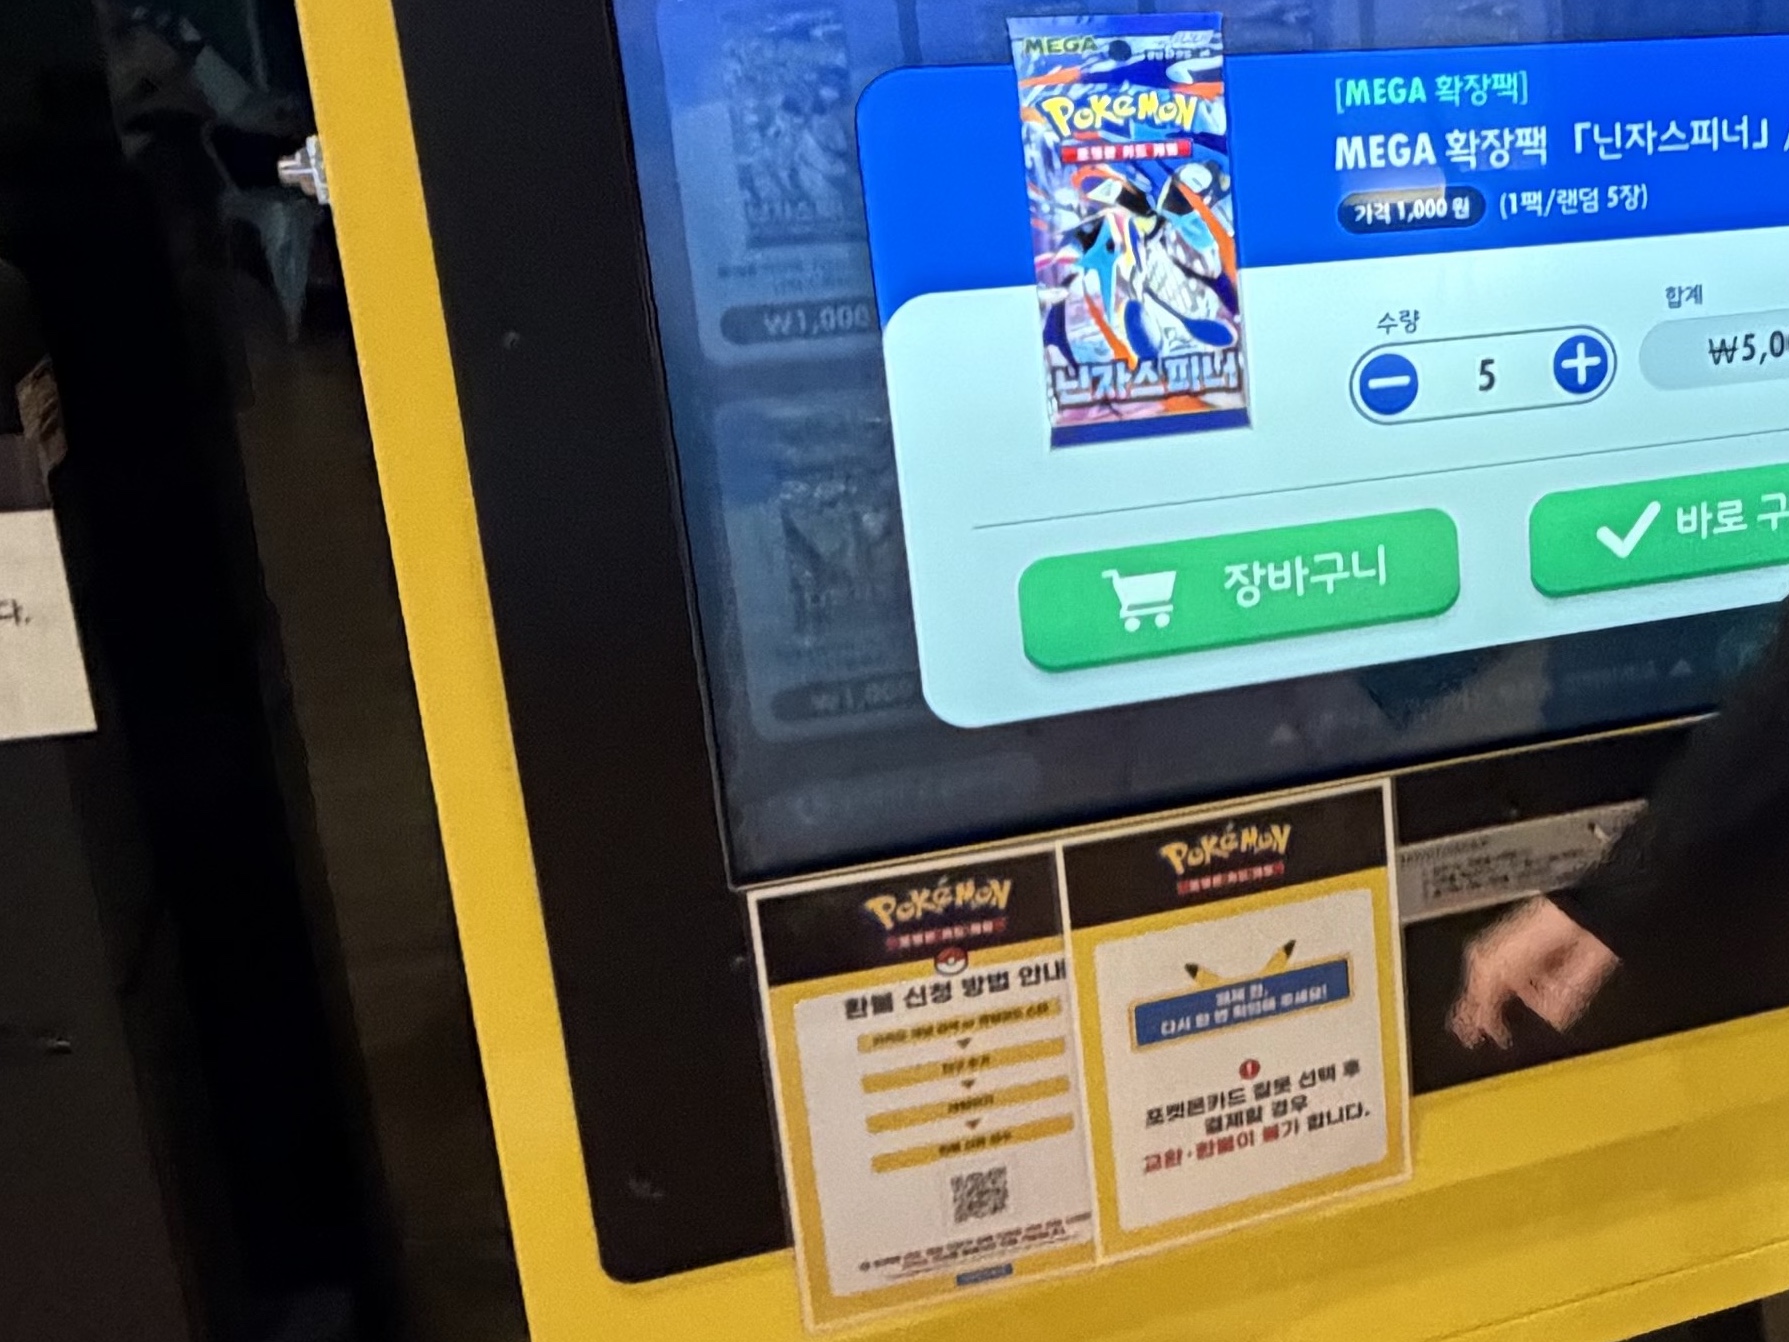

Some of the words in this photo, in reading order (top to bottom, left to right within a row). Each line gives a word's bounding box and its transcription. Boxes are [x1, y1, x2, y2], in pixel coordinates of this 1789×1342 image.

[1025, 36, 1098, 54] MEGA
[1335, 77, 1427, 115] [MEGA
[1435, 70, 1528, 107] 확장팩]
[1334, 132, 1437, 171] MEGA
[1445, 125, 1547, 170] 확장팩
[1354, 202, 1391, 225] 가격
[1397, 198, 1448, 222] 1,000
[1451, 196, 1470, 220] 원
[1500, 186, 1599, 220] (1팩/랜덤
[1607, 183, 1648, 212] 5장)
[1664, 283, 1703, 308] 합계
[1377, 309, 1420, 334] 수량
[1055, 350, 1239, 405] 닌자스피너
[1478, 357, 1496, 392] 5
[1676, 499, 1748, 540] 바로
[1223, 545, 1386, 608] 장바구니
[903, 981, 953, 1009] 신청
[962, 970, 1010, 998] 방법
[1018, 958, 1067, 988] 안내
[1161, 1015, 1191, 1037] 다시
[1146, 1086, 1247, 1129] 포켓몬카드
[1299, 1063, 1336, 1090] 선택
[1272, 1094, 1309, 1119] 경우
[1307, 1101, 1371, 1133] 합니다.
